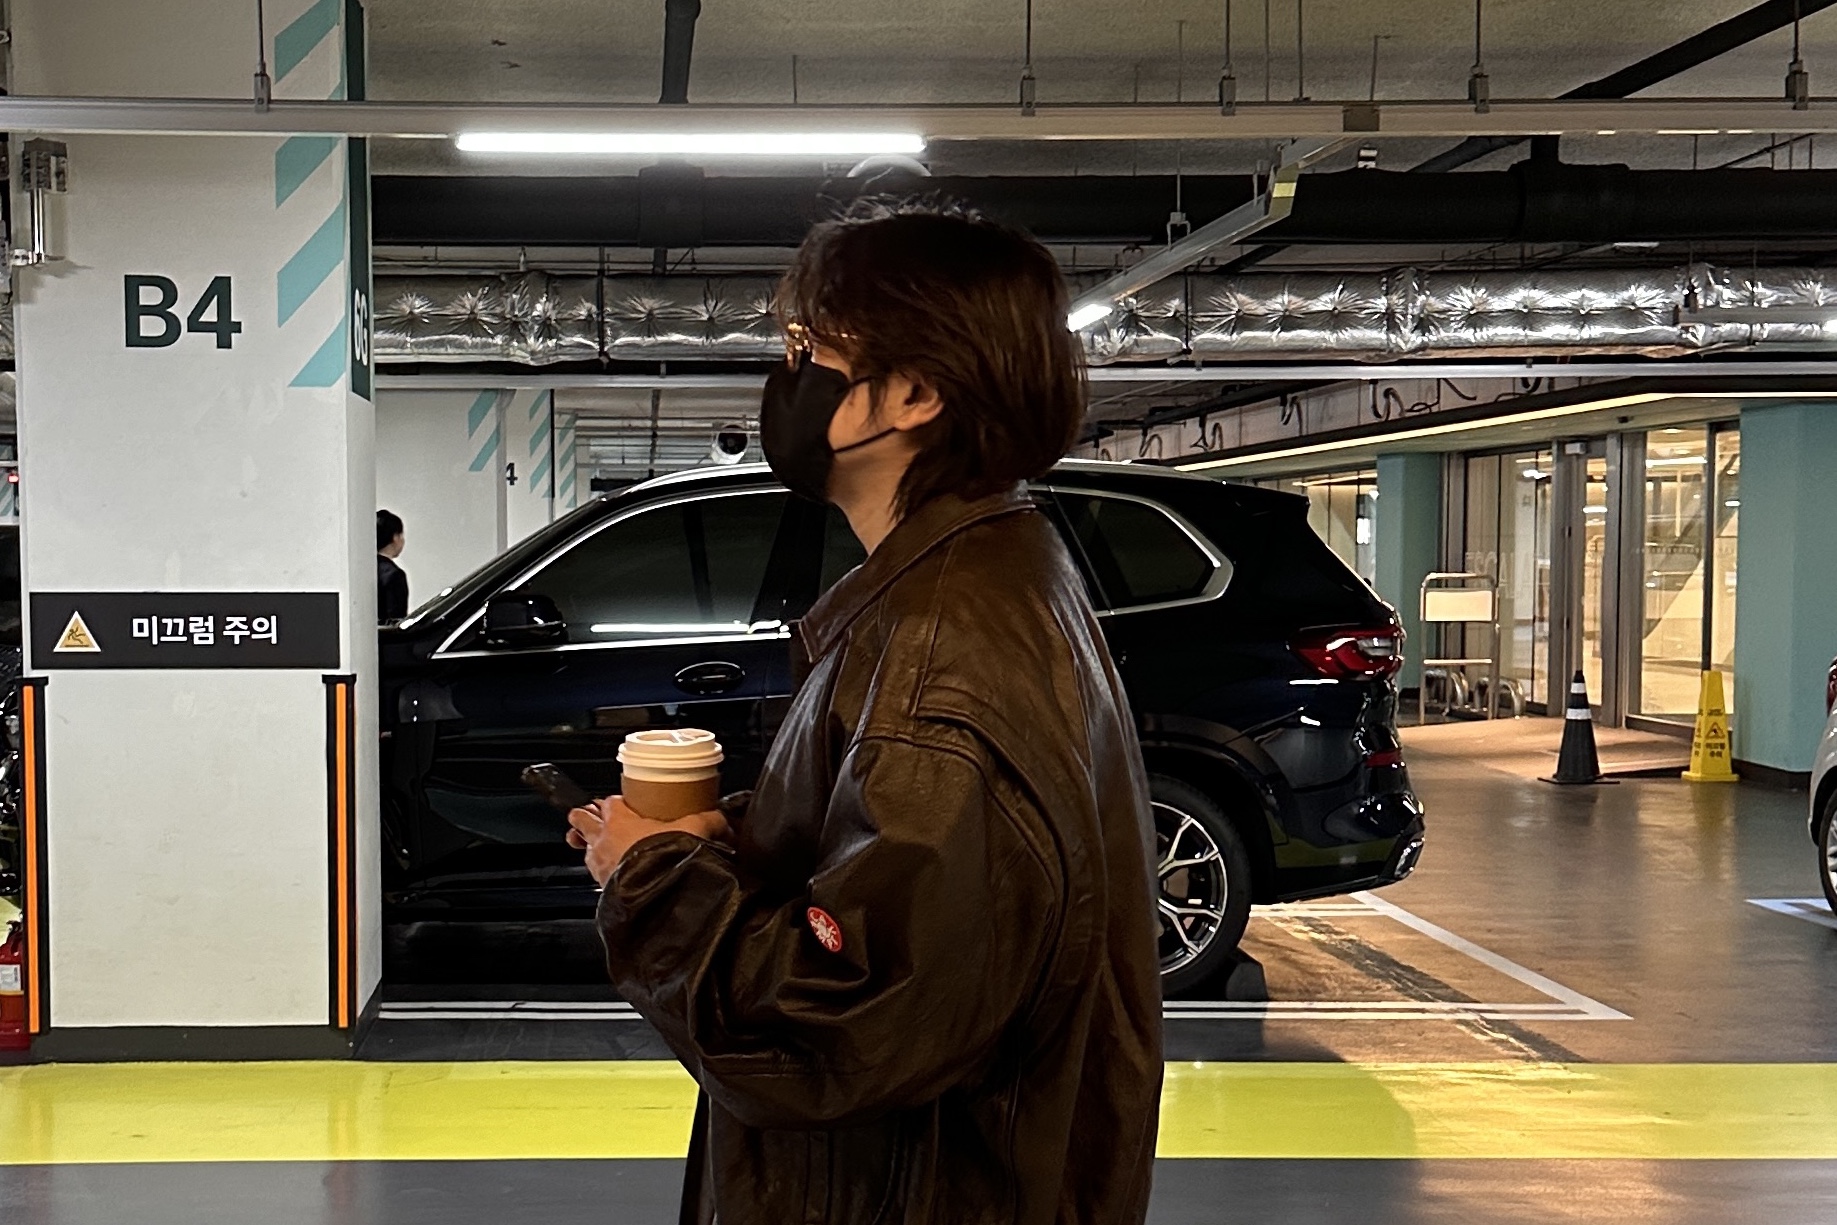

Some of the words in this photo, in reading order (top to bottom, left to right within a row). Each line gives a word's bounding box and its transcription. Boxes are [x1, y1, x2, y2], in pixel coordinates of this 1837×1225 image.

[124, 274, 242, 349] B4
[132, 615, 214, 646] 미끄럼
[222, 615, 277, 645] 주의
